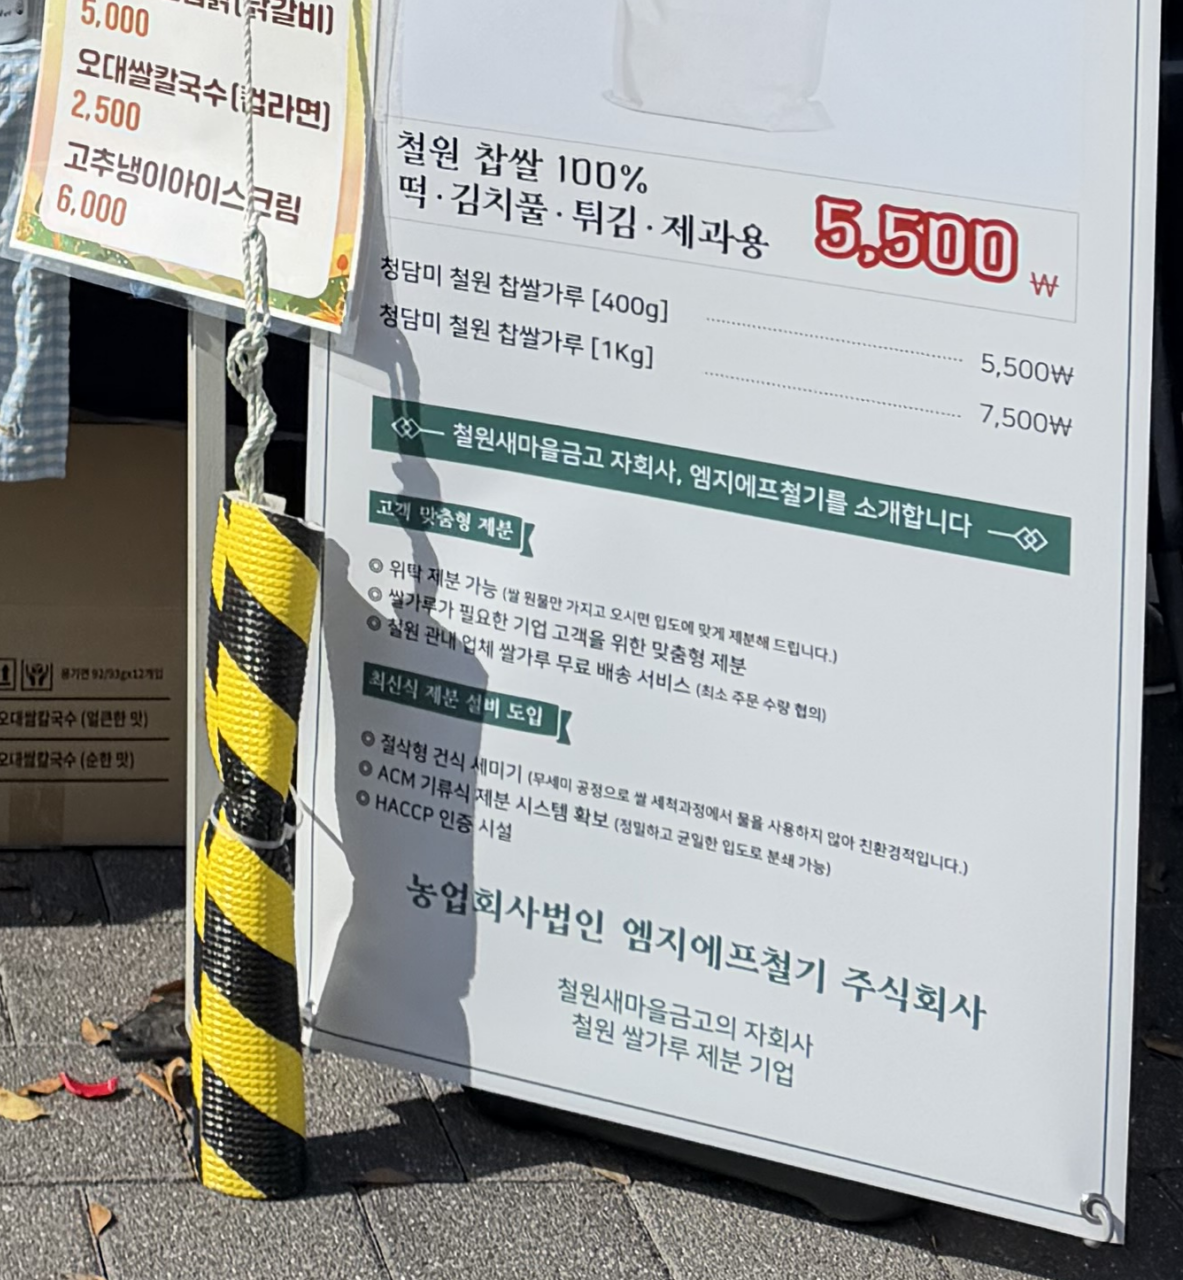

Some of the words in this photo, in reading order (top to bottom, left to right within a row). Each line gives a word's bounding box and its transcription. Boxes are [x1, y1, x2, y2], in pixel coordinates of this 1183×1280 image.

[71, 90, 141, 132] 2,500
[56, 183, 127, 228] 6,000
[64, 141, 303, 226] 고추냉이아이스크림
[397, 131, 458, 171] 철원
[475, 142, 543, 182] 찹쌀
[559, 155, 647, 194] 100%
[815, 194, 1018, 284] 5,500
[381, 256, 441, 287] 청담미
[450, 267, 490, 294] 철원
[499, 274, 584, 307] 찹쌀가루
[593, 289, 667, 323] [400g]
[380, 304, 440, 337] 청담미
[450, 315, 489, 342] 철원
[498, 322, 584, 356] 찹쌀가루
[592, 337, 653, 369] [1Kg]
[453, 423, 604, 468] 철원새마을금고
[610, 451, 682, 486] 자회사,
[690, 464, 848, 516] 엠지에프철기를
[854, 497, 972, 538] 소개합니다
[376, 500, 411, 521] 고객
[420, 506, 471, 532] 맞춤형
[478, 517, 513, 540] 제분
[389, 589, 454, 619] 쌀가루가
[460, 604, 508, 631] 필요한
[514, 616, 547, 639] 기업
[552, 624, 605, 650] 고객을
[611, 634, 646, 657] 위한
[652, 641, 704, 668] 맞춤형
[711, 653, 746, 676] 제분
[130, 710, 148, 728] 맛)
[369, 670, 418, 699] 최신식
[425, 685, 459, 709] 제분
[466, 694, 500, 719] 설비
[506, 703, 542, 727] 도입
[117, 751, 135, 769] 맛)
[376, 794, 434, 822] HACCP
[439, 809, 473, 833] 인증
[479, 819, 512, 842] 시설
[407, 874, 603, 944] 농업회사법인
[623, 918, 825, 994] 엠지에프철기
[842, 968, 987, 1030] 주식회사
[558, 978, 736, 1041] 철원새마을금고의
[744, 1021, 813, 1058] 자회사
[572, 1013, 614, 1045] 철원
[622, 1025, 689, 1061] 쌀가루
[697, 1044, 742, 1075] 제분
[750, 1056, 793, 1087] 기업
